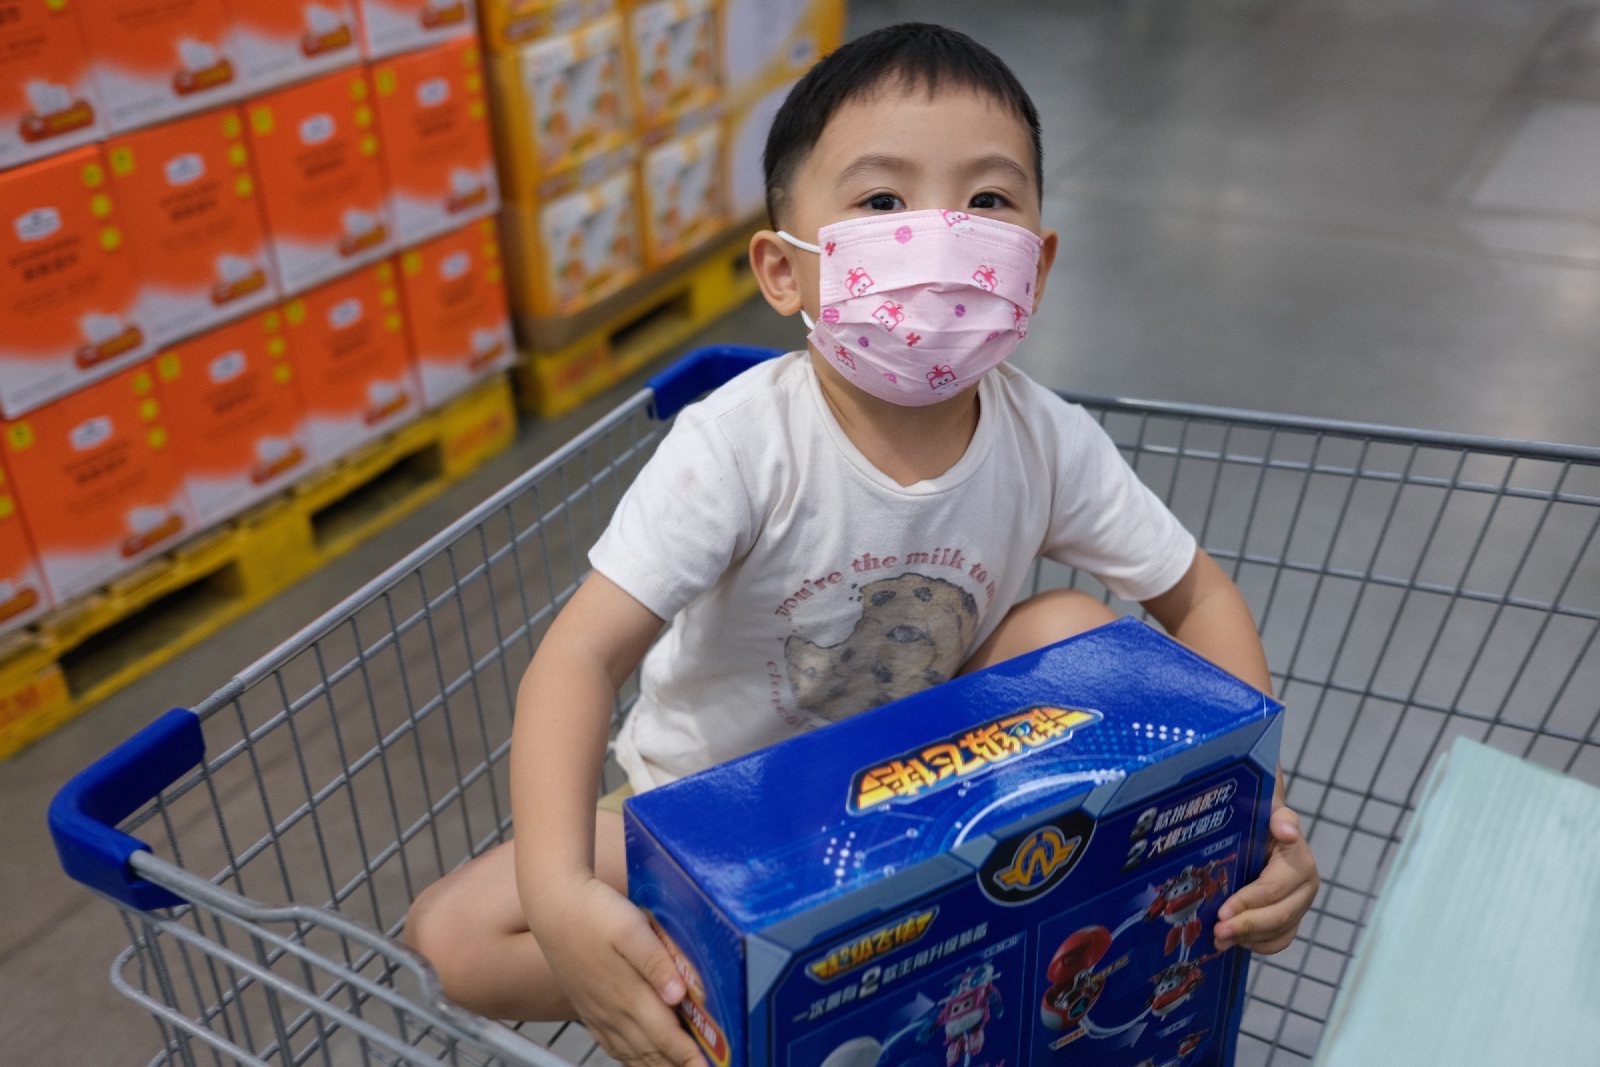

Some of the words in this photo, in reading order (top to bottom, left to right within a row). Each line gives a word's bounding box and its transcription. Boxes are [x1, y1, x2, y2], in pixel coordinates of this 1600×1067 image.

[774, 570, 843, 617] you're
[851, 553, 898, 573] the
[905, 547, 965, 570] milk
[968, 563, 988, 584] to
[862, 707, 1090, 806] 超级飞侠
